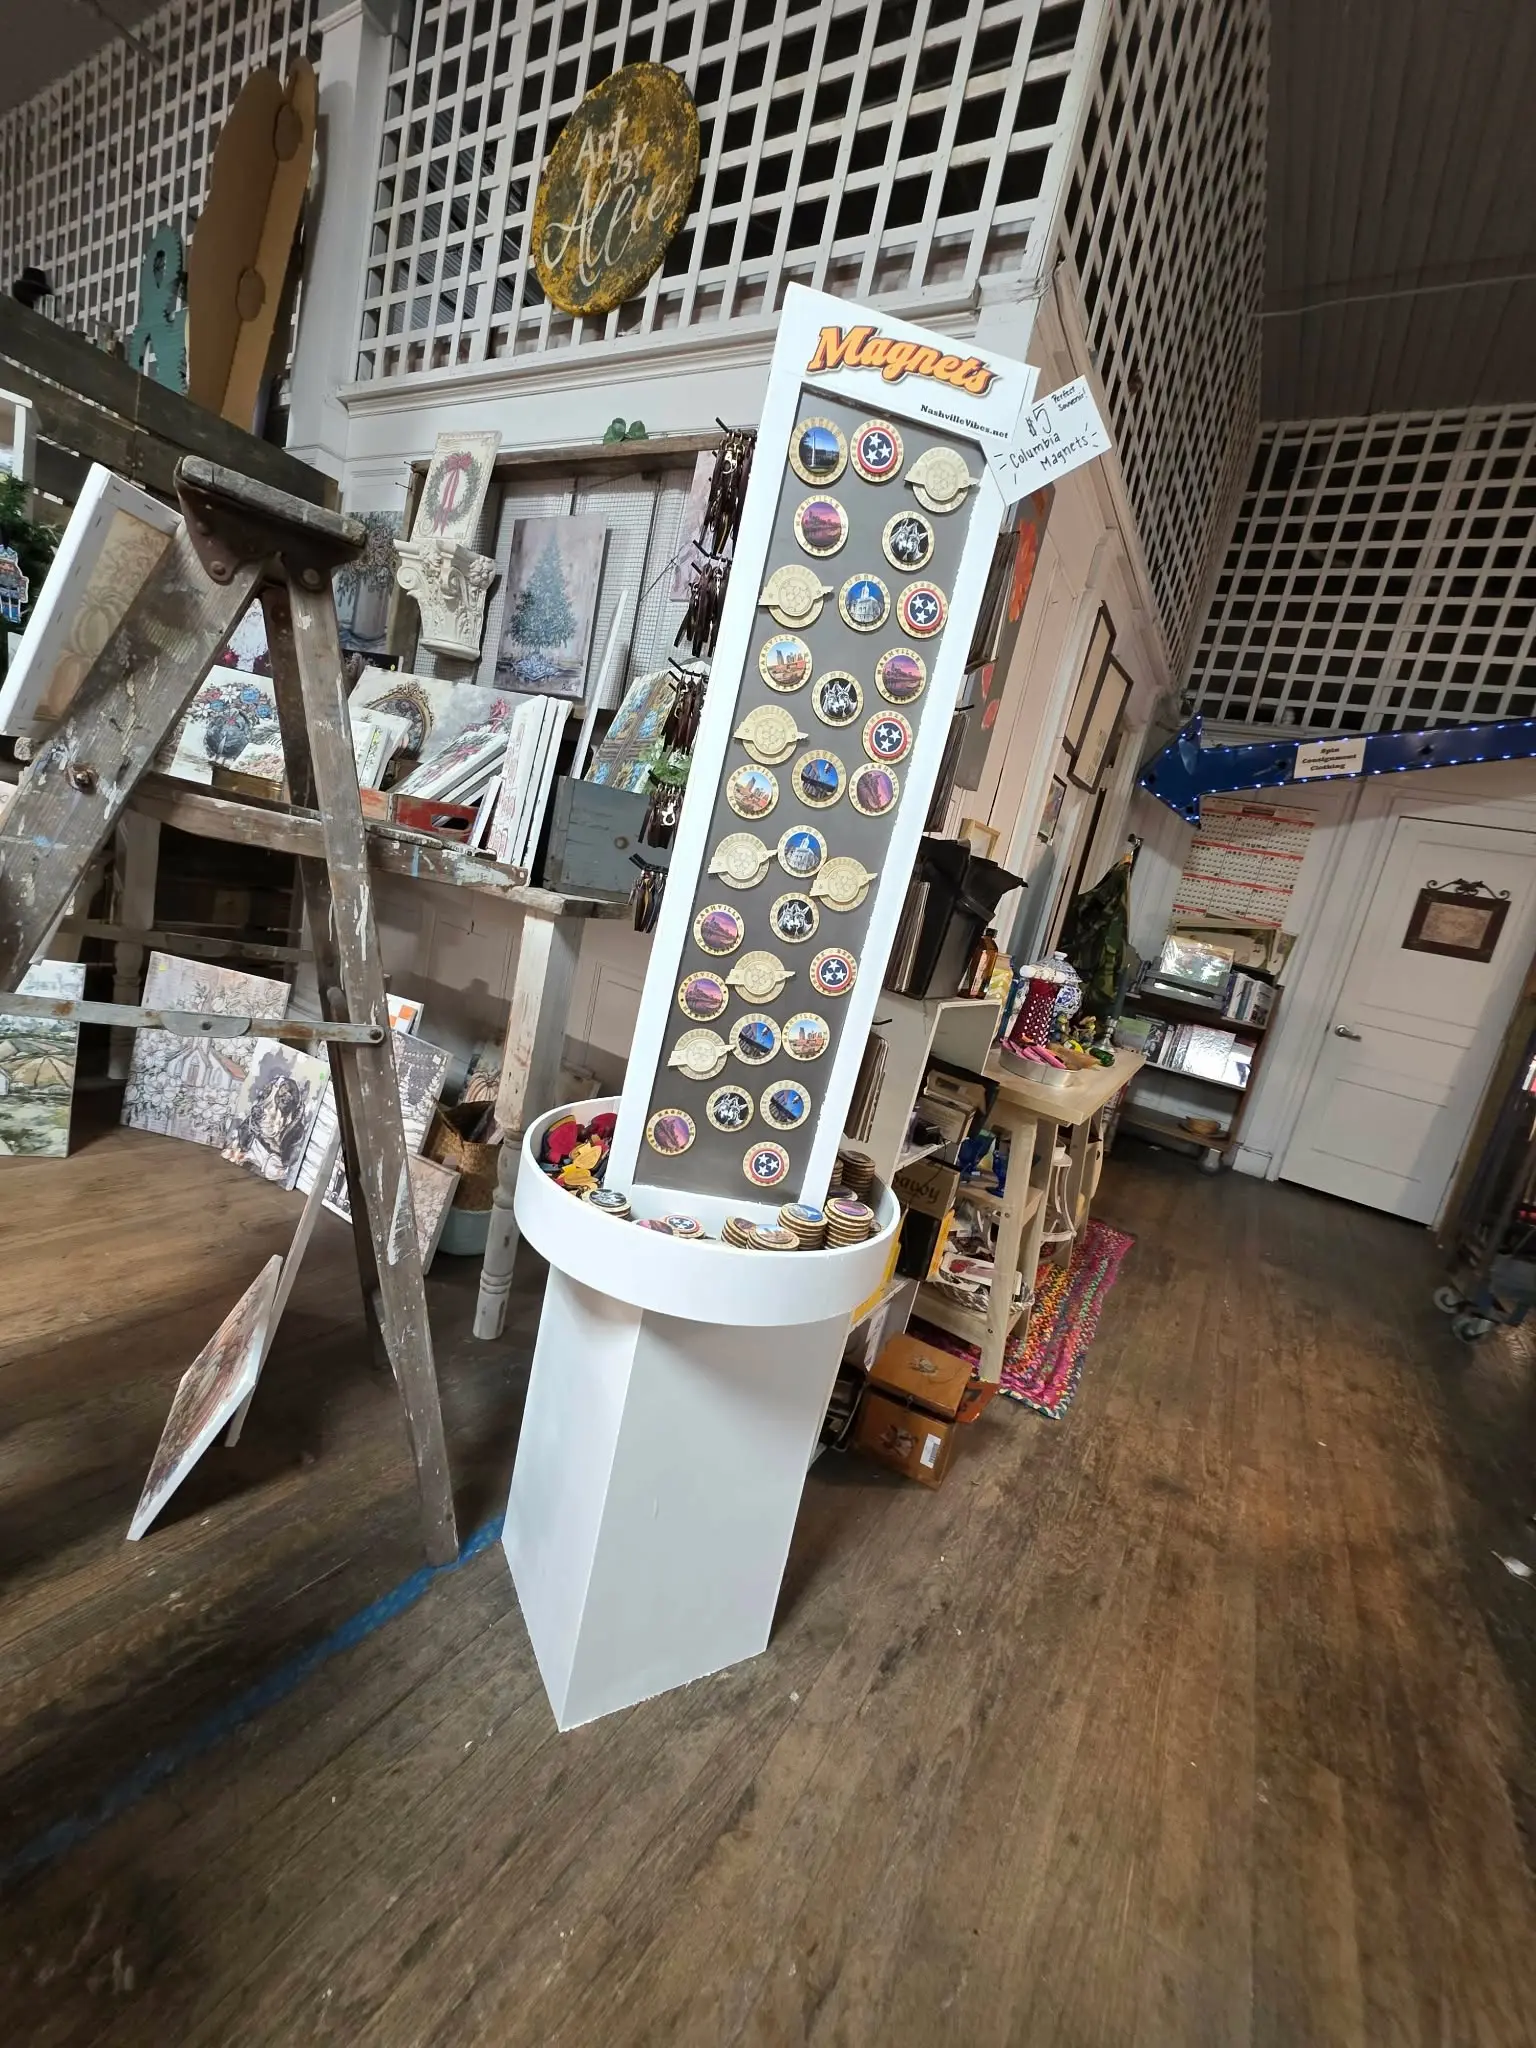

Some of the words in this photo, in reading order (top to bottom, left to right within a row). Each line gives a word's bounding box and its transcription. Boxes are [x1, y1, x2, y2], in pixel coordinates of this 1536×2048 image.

[572, 108, 629, 175] Art
[807, 325, 999, 397] Magnets
[1051, 386, 1075, 403] Perfect
[920, 403, 1009, 439] NashvilleVibes.net
[1025, 403, 1052, 437] $5
[1009, 432, 1061, 469] Columbia
[1040, 435, 1089, 471] Magnets
[1310, 762, 1347, 772] Clothing
